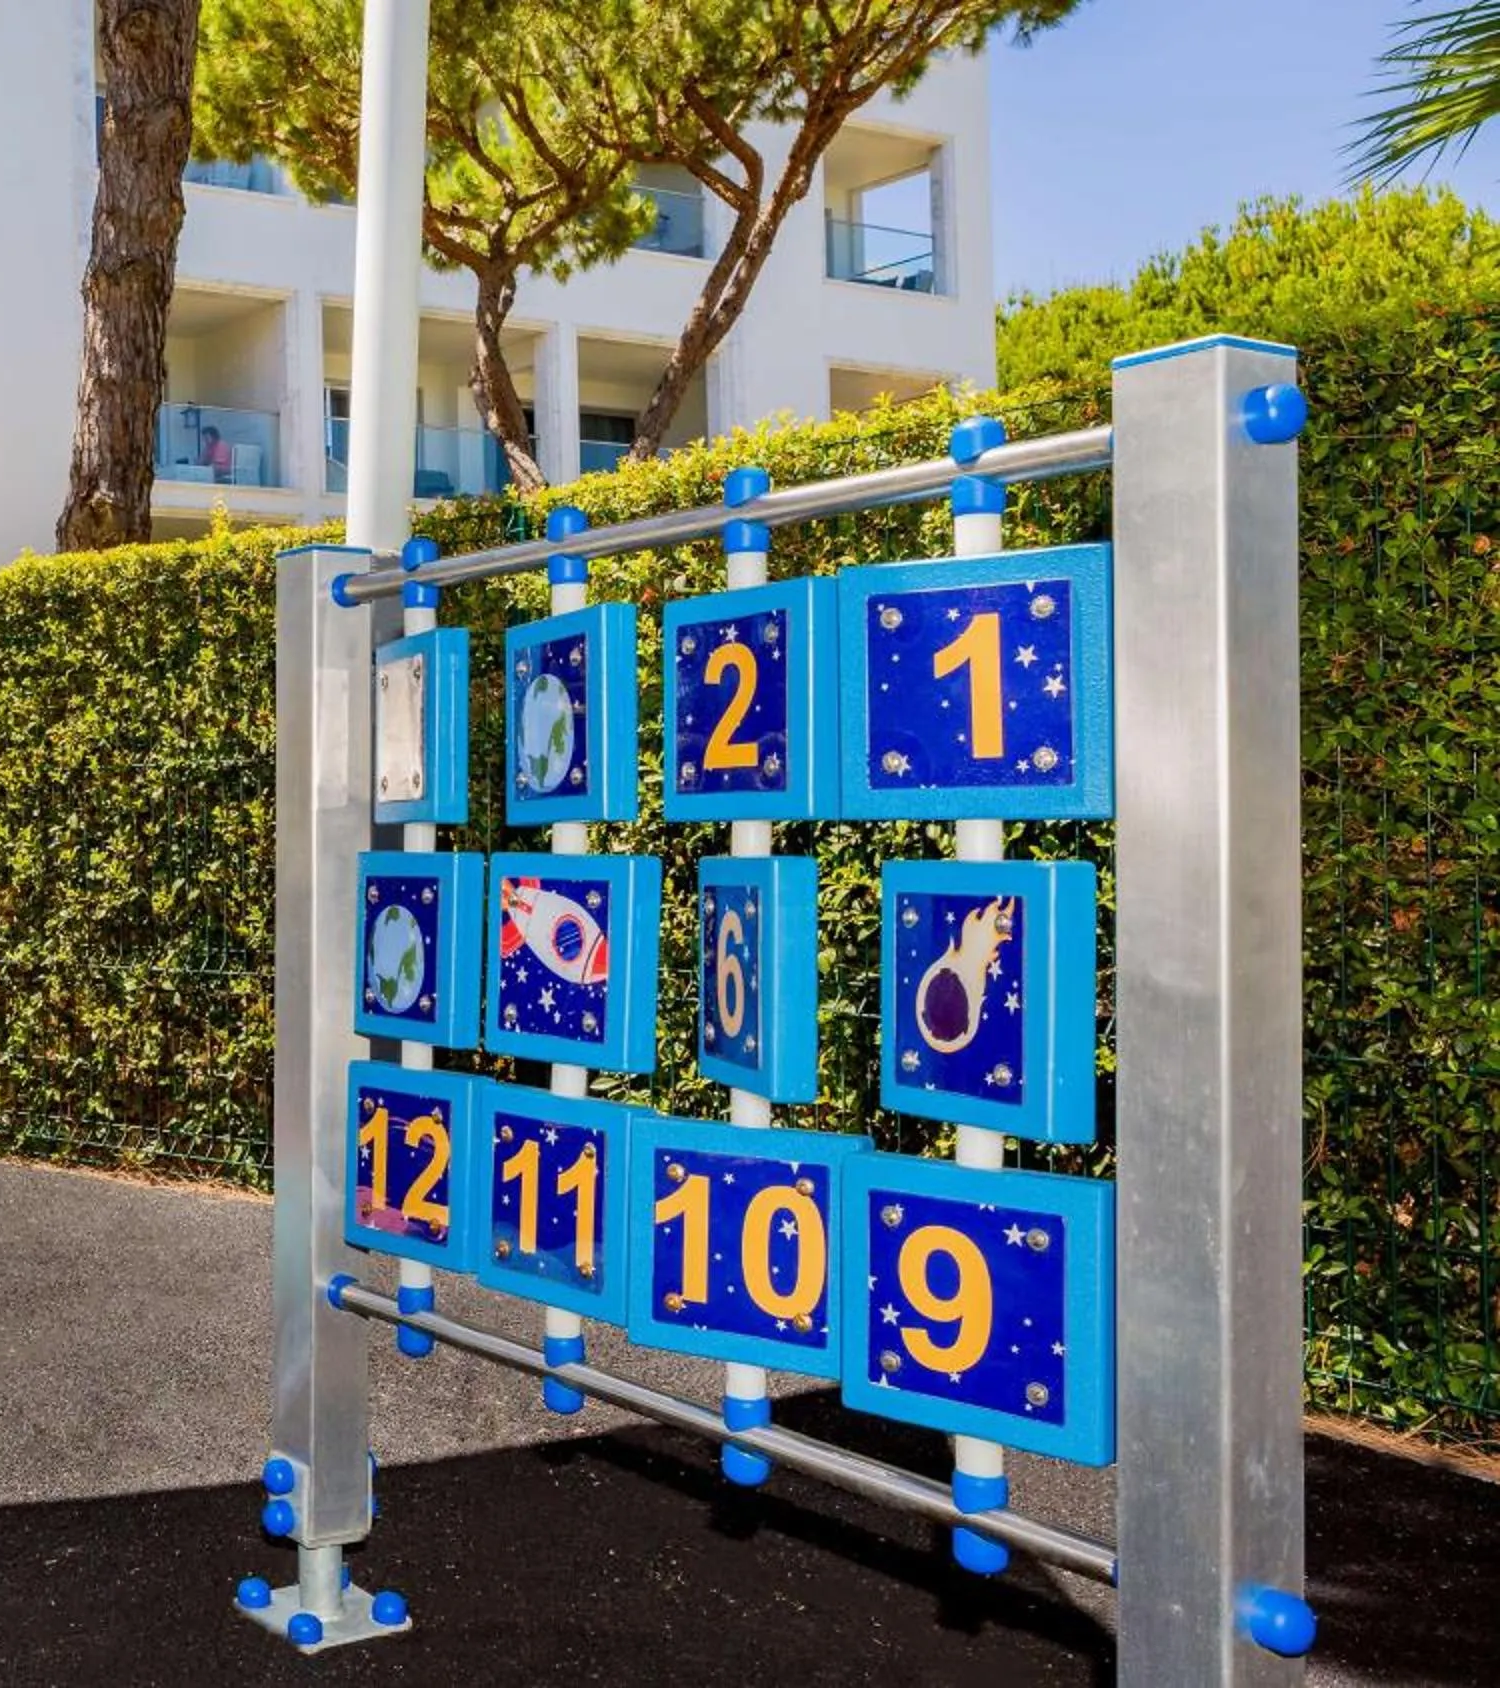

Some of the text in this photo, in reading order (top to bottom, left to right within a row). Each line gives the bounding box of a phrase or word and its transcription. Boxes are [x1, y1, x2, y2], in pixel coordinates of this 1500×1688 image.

[704, 642, 758, 769] 2
[935, 614, 1003, 758] 1
[716, 910, 745, 1038] 6
[359, 1108, 450, 1228] 12
[503, 1140, 596, 1274] 11
[656, 1176, 826, 1320] 10
[899, 1226, 992, 1374] 9
